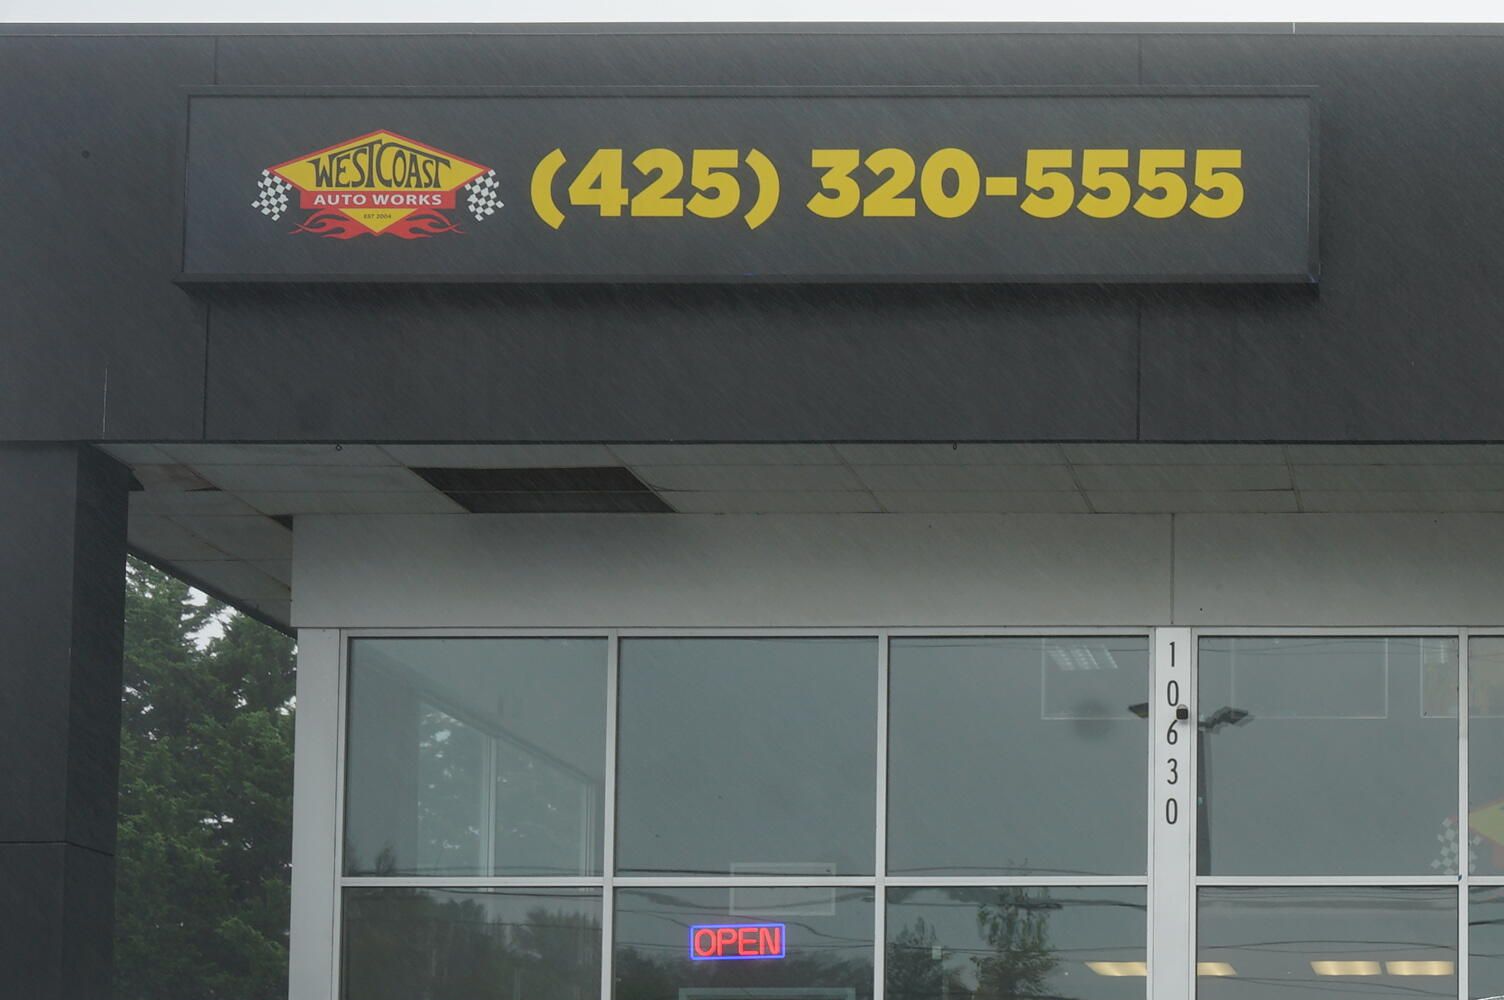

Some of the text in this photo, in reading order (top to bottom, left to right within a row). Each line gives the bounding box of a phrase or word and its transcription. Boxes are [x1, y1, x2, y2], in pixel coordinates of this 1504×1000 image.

[313, 193, 442, 206] AUTO WORKS
[531, 148, 1244, 229] (425) 320-5555
[1165, 641, 1180, 825] 10630
[693, 927, 782, 956] OPEN
